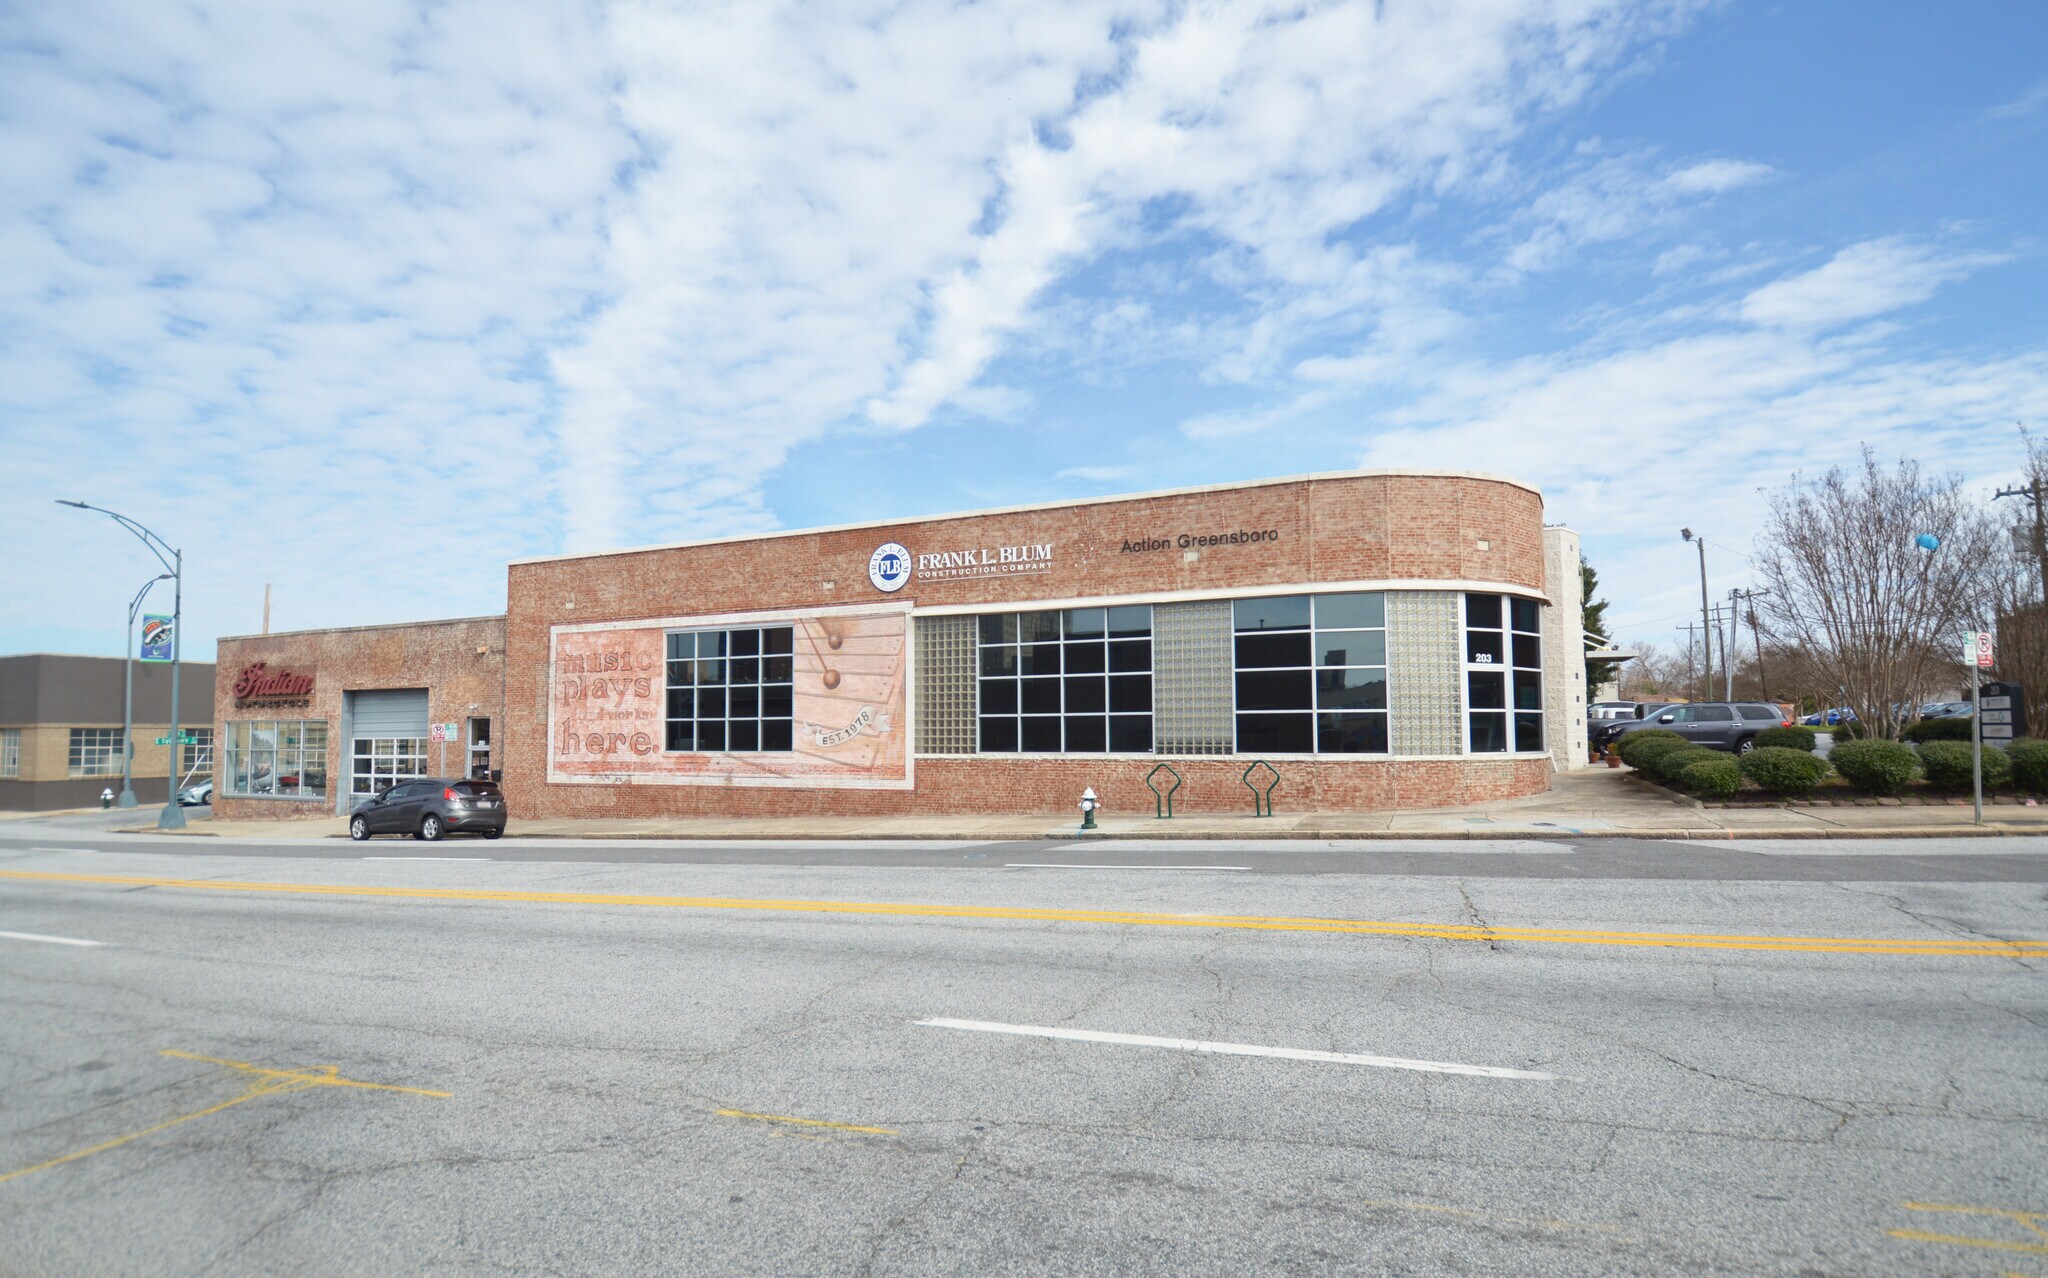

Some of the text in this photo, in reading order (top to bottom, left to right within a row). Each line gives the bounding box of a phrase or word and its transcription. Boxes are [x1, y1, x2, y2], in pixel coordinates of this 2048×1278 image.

[1121, 529, 1278, 553] Action Greensboro
[880, 559, 901, 575] FLB
[918, 543, 1052, 570] FRANK L. BLUM
[918, 562, 1052, 578] CONSTRUCTION COMPANY
[563, 645, 651, 674] music
[1475, 653, 1492, 663] 203
[233, 663, 313, 698] Indian
[562, 675, 651, 708] plays
[561, 717, 660, 756] here.
[822, 711, 870, 745] EST. 1978
